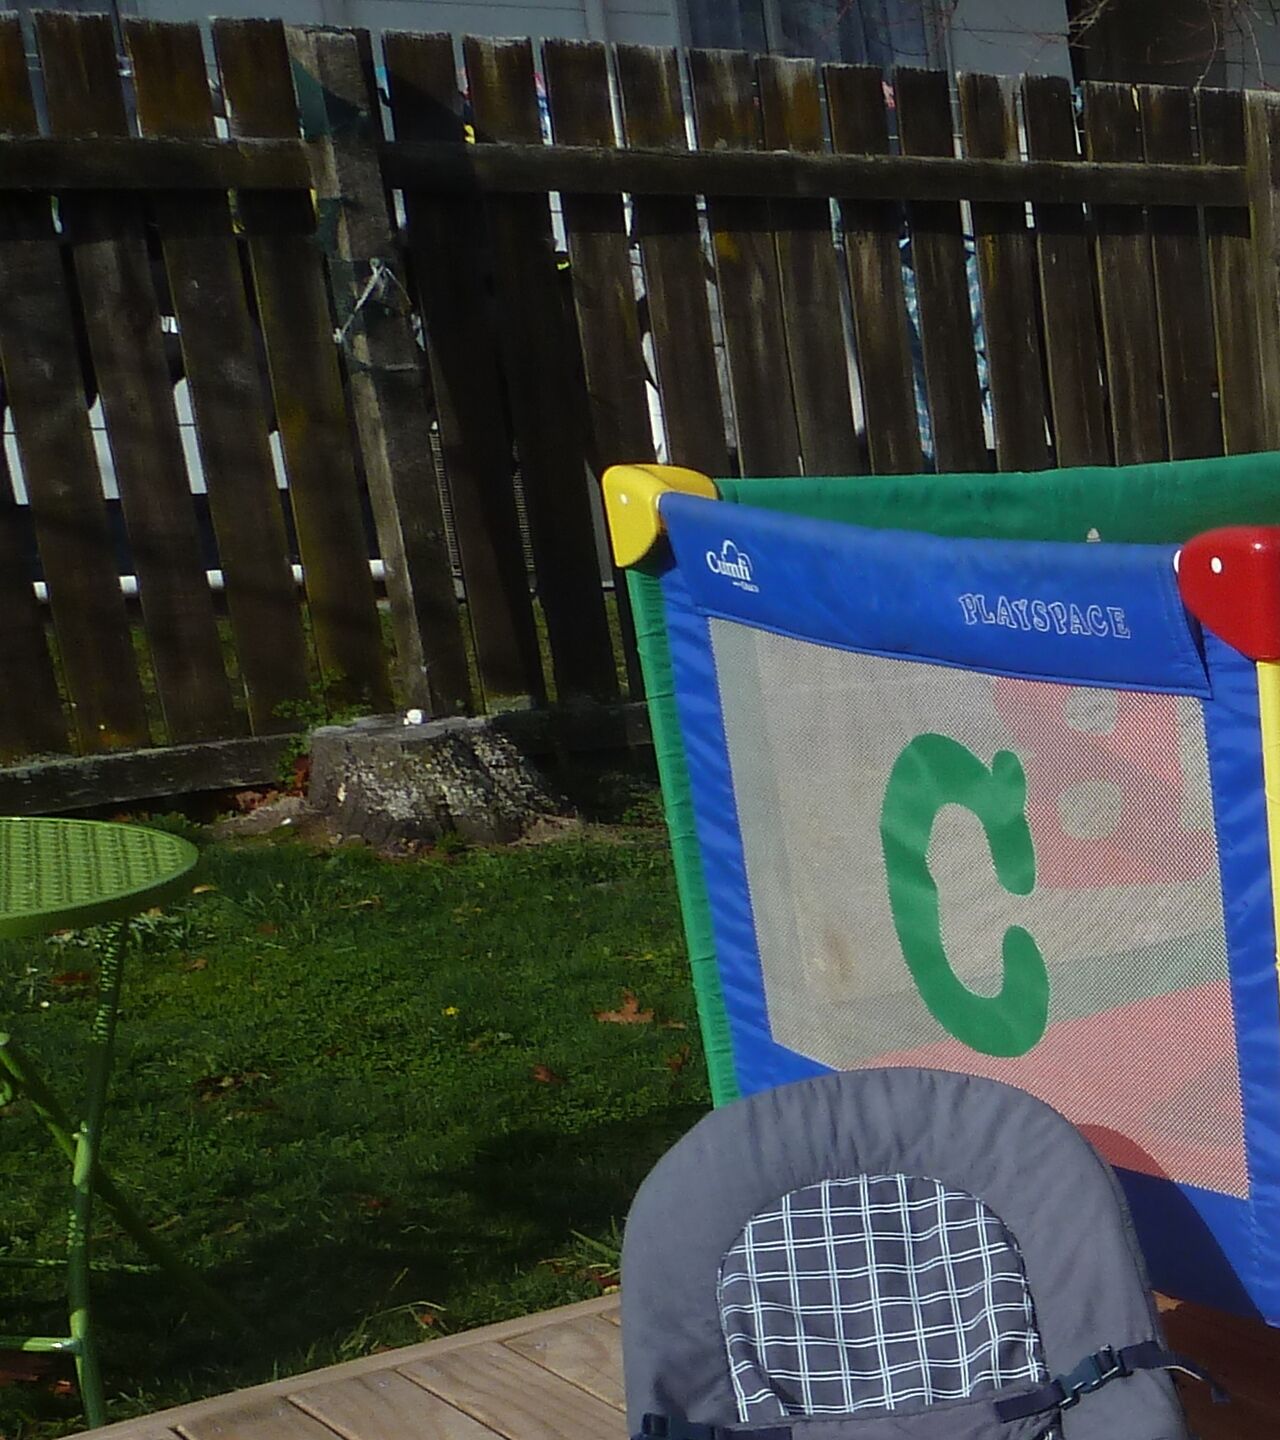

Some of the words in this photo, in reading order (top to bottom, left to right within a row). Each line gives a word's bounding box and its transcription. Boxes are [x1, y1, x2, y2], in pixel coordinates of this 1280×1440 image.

[705, 550, 752, 582] Cumfi
[958, 593, 1131, 640] PLAYSPACE
[880, 732, 1050, 1058] C
